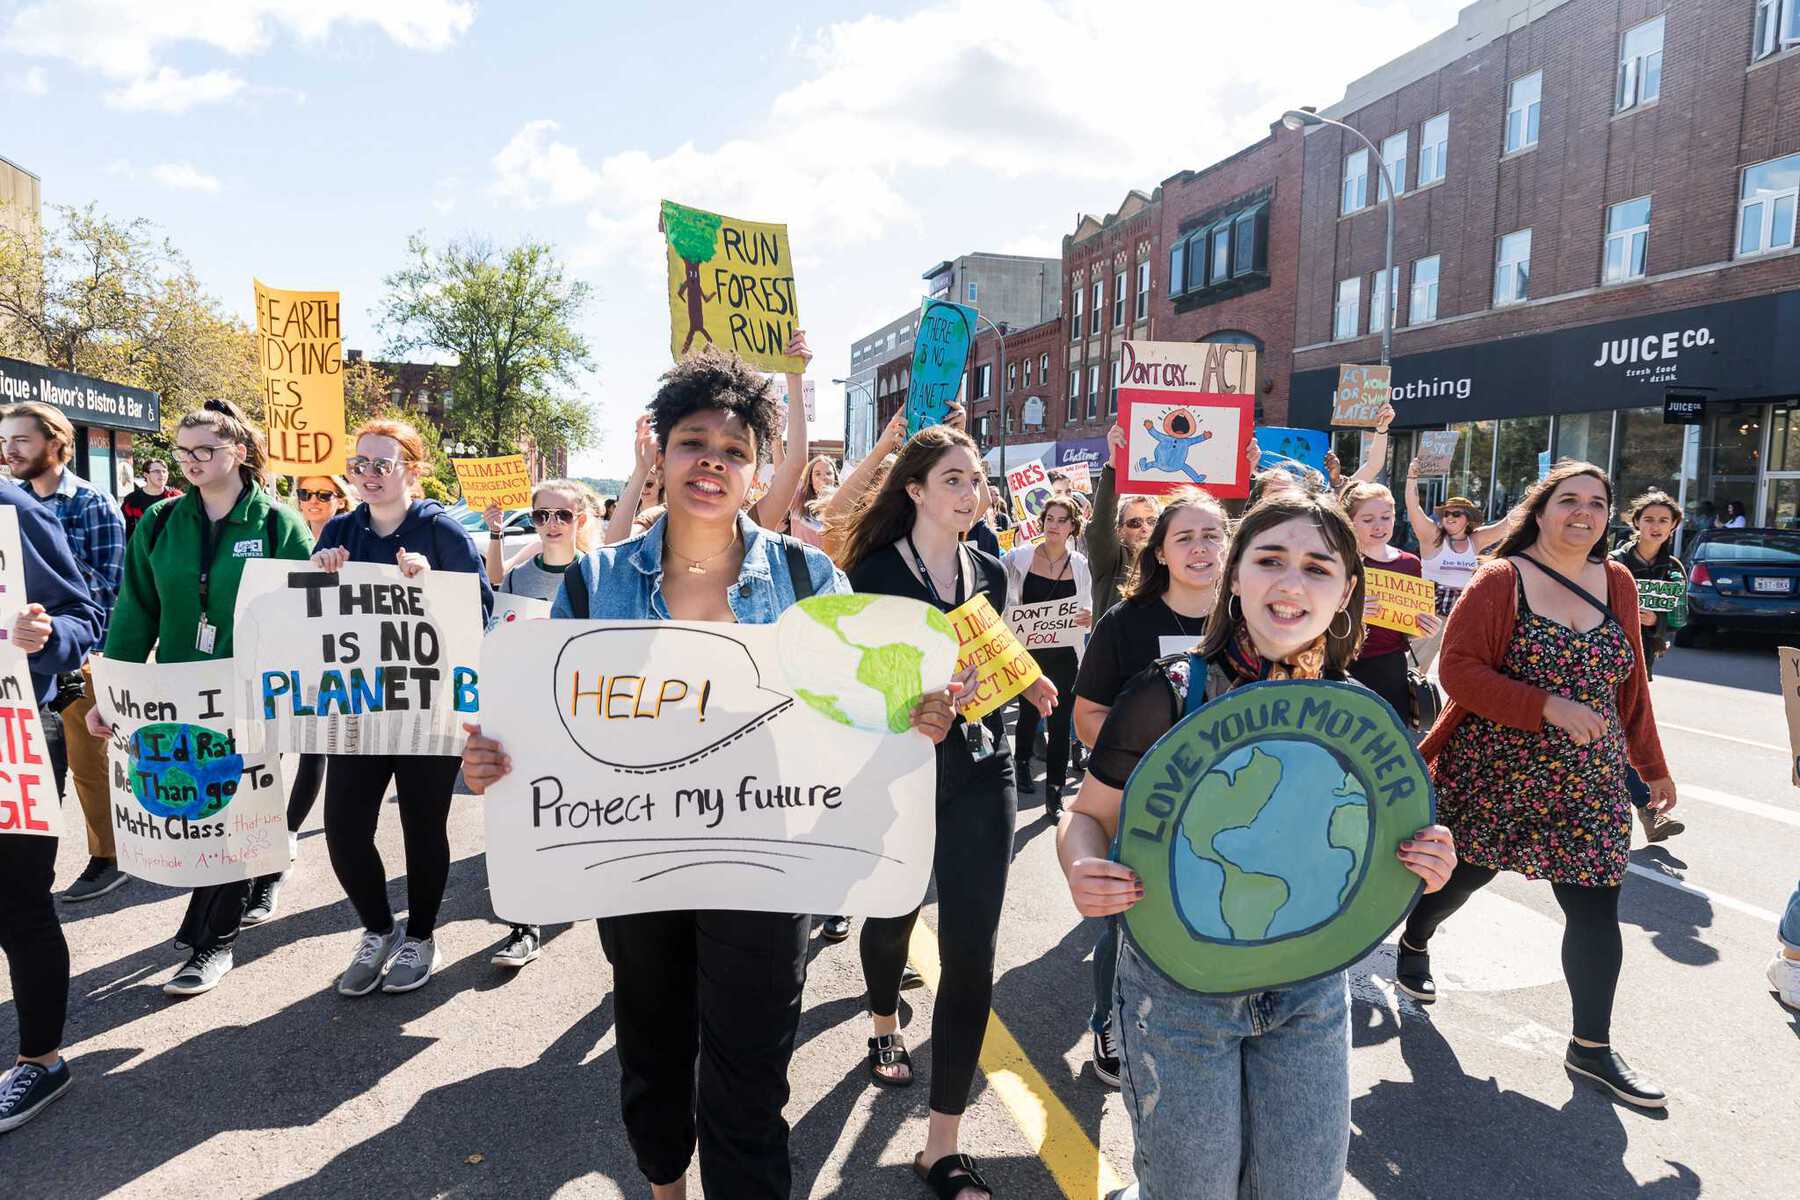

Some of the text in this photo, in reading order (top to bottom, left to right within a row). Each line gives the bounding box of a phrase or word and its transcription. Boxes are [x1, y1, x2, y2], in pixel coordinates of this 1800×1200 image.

[722, 227, 779, 266] RUN
[715, 268, 795, 316] FOREST
[269, 299, 340, 339] EARTH
[729, 313, 793, 356] RUN!
[928, 316, 954, 345] THERE
[267, 339, 341, 375] DYING
[933, 345, 946, 367] NO
[1594, 327, 1715, 367] JUICE CO.
[1201, 343, 1256, 394] ACT
[1626, 364, 1677, 377] fresh food
[1650, 373, 1677, 383] drink
[40, 379, 84, 411] Mavor's
[86, 389, 116, 413] Bistro
[118, 395, 126, 416] &
[128, 397, 143, 418] Bar
[1392, 377, 1472, 400] othing
[1668, 403, 1693, 411] JUICE
[456, 460, 524, 477] CLIMATE
[462, 478, 528, 491] EMERGENCY
[491, 492, 528, 507] NOW
[288, 571, 425, 618] THERE
[1366, 572, 1433, 600] CLIMATE
[1012, 601, 1078, 623] DON'T BE
[1016, 619, 1078, 634] A FOSSIL
[322, 631, 360, 663] IS
[381, 621, 440, 666] NO
[1026, 632, 1059, 646] FOOL
[108, 686, 225, 721] When I
[262, 666, 479, 720] PLANET B
[572, 670, 710, 722] HELP!
[115, 761, 274, 810] Die Than go To
[1130, 697, 1416, 843] LOVE YOUR MOTHER
[530, 775, 843, 828] Protect my future
[115, 804, 163, 840] Math
